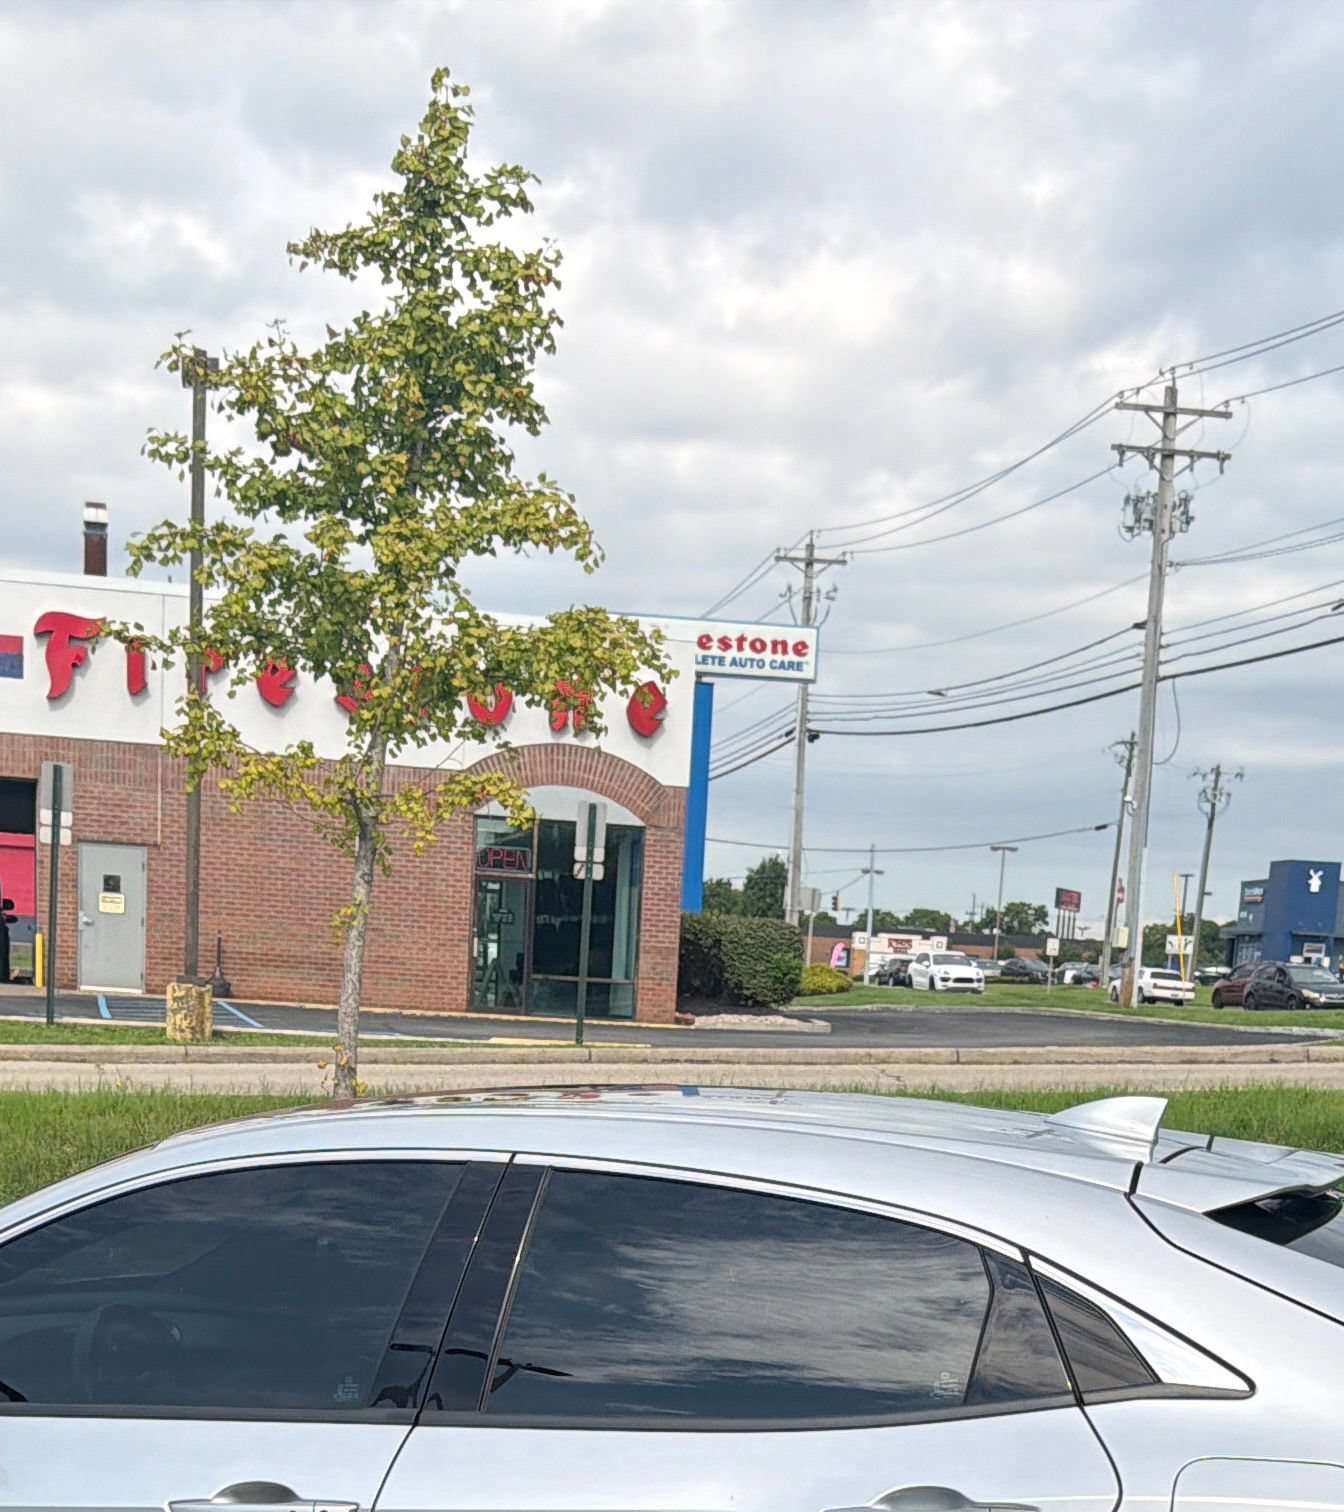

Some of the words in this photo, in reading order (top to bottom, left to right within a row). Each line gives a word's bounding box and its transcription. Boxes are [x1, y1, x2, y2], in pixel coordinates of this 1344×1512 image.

[729, 656, 765, 670] AUTO
[769, 660, 804, 672] CARE
[478, 848, 529, 870] OPEN
